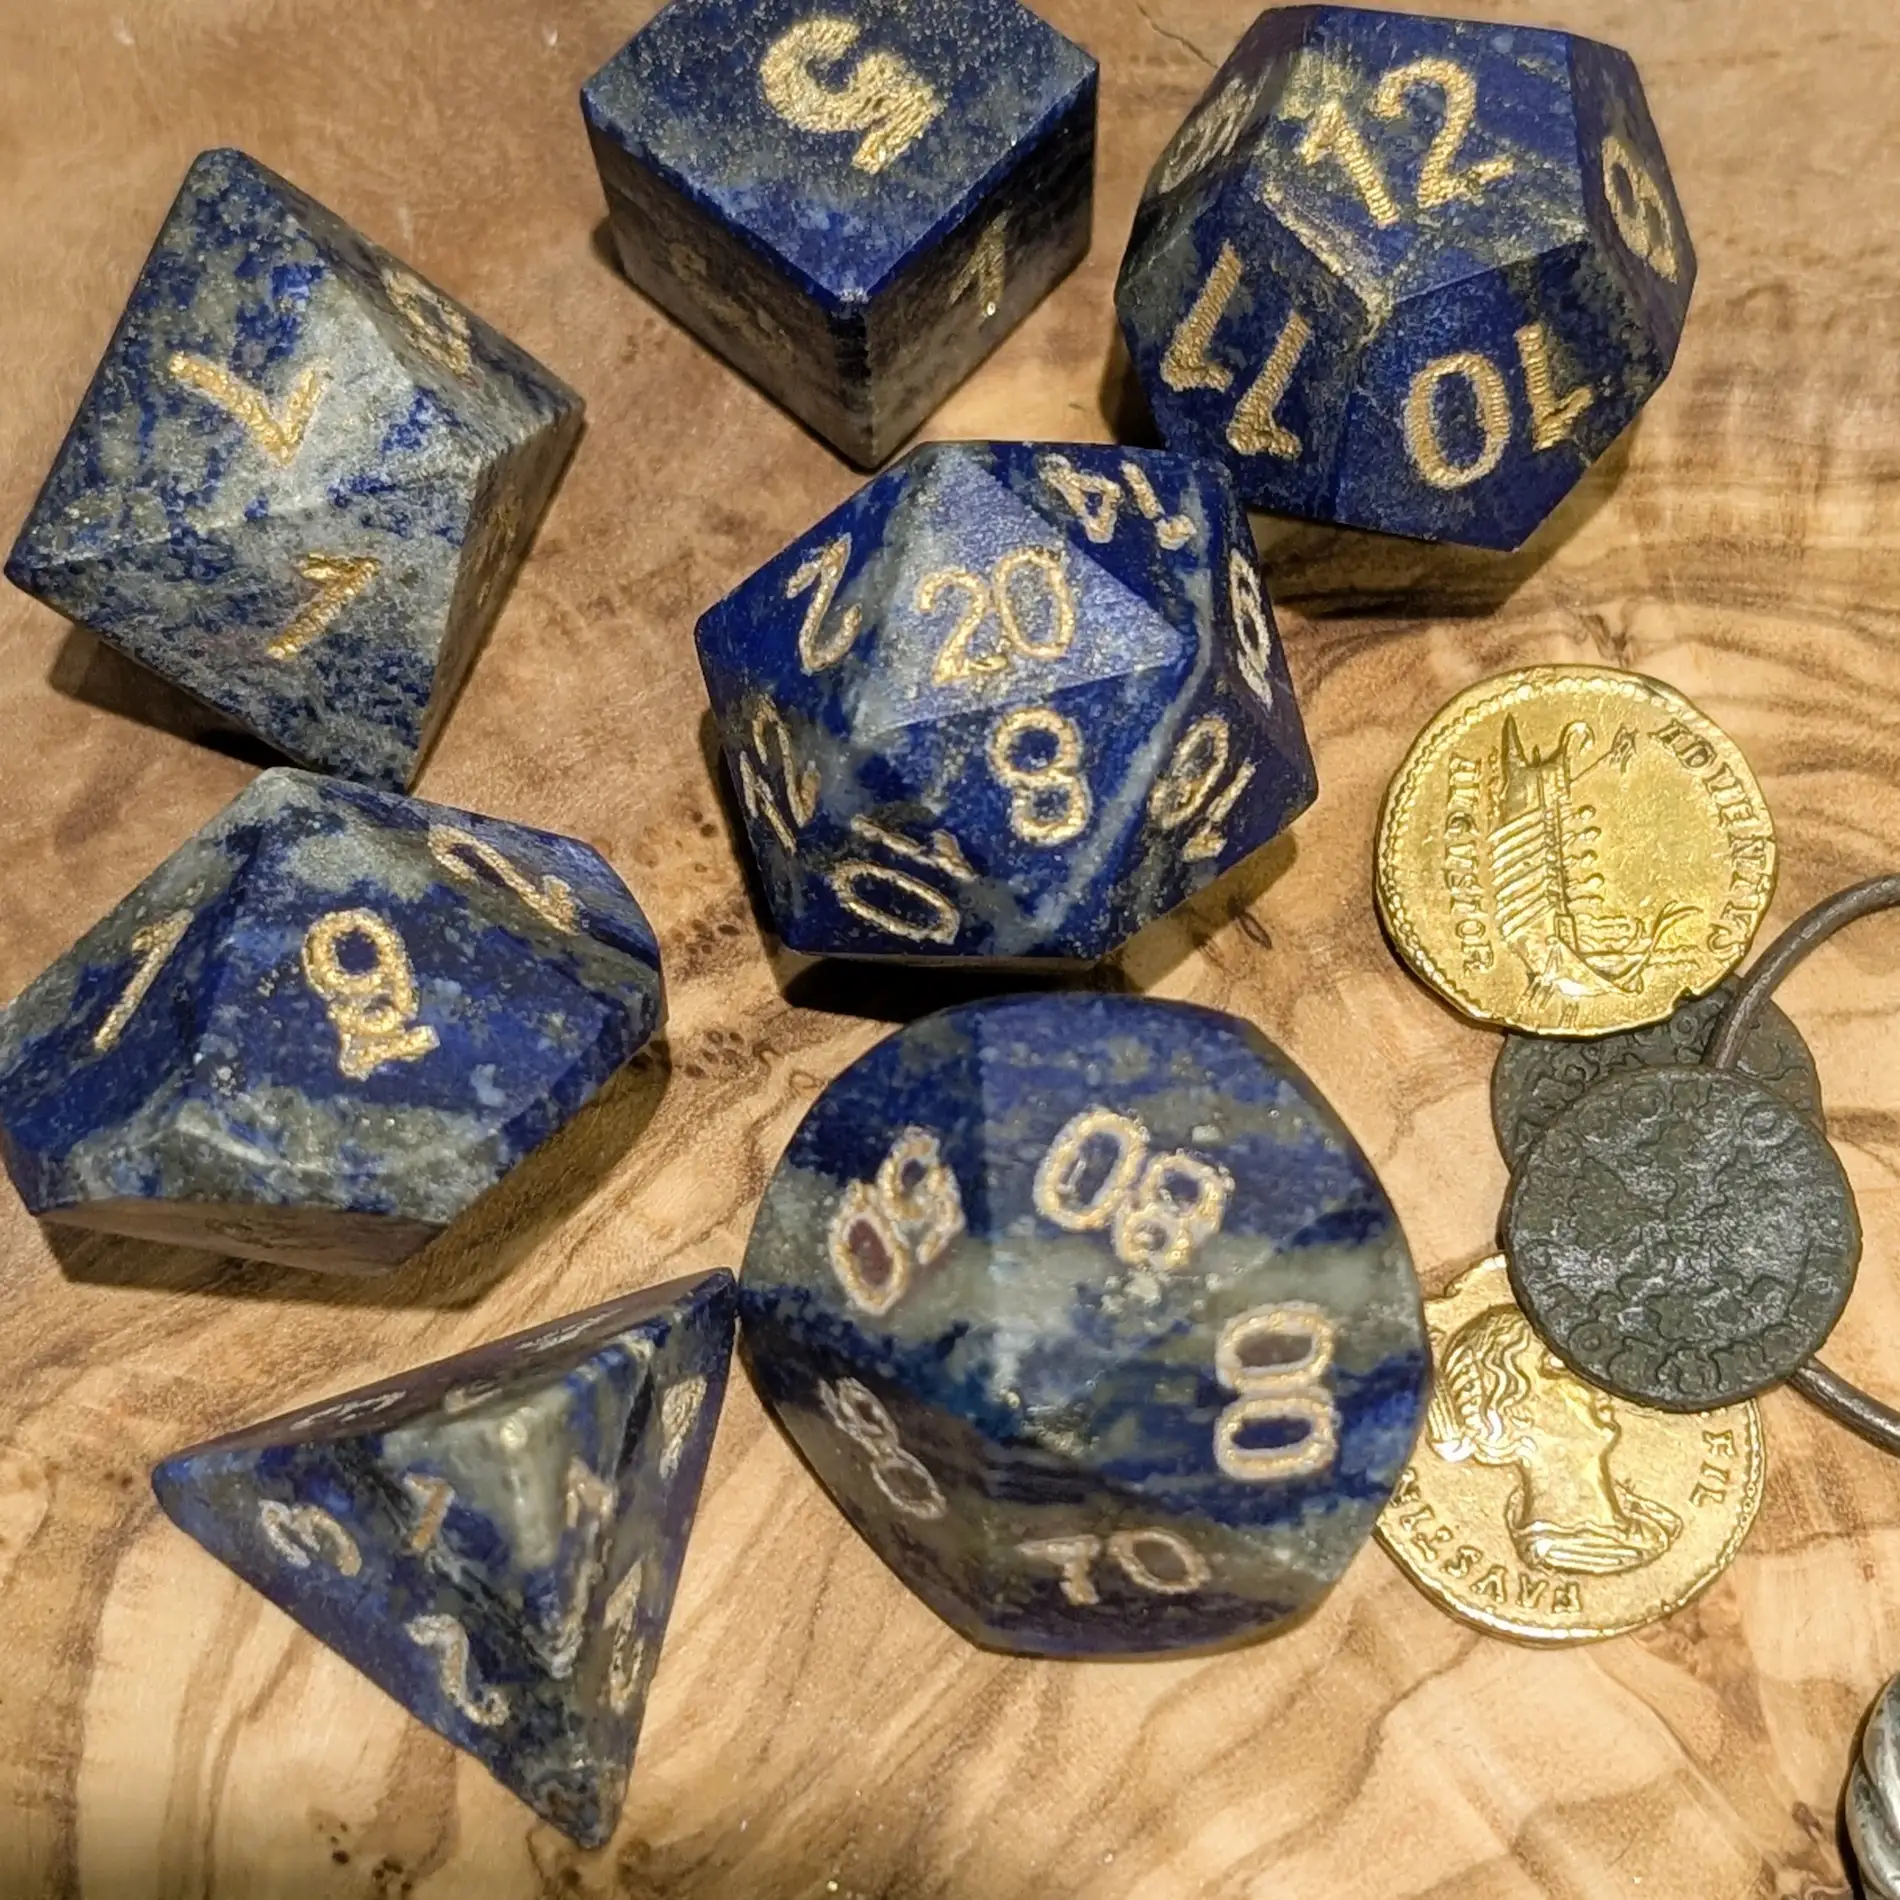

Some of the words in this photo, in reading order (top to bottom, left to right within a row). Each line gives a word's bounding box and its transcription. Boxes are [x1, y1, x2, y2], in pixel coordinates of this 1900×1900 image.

[758, 16, 947, 175] 5
[1297, 57, 1516, 228] 12
[1159, 238, 1314, 458] 11
[1404, 322, 1595, 489] 10
[1038, 453, 1197, 550] 14
[787, 532, 863, 675] 2
[914, 545, 1078, 688] 20
[738, 695, 820, 857] 12
[986, 706, 1093, 847] 8
[827, 815, 979, 946] 10
[94, 910, 194, 1056] 1
[1213, 1301, 1341, 1482] 00
[258, 1497, 364, 1578] 3
[1690, 1429, 1738, 1507] FIL
[405, 1612, 510, 1727] 2
